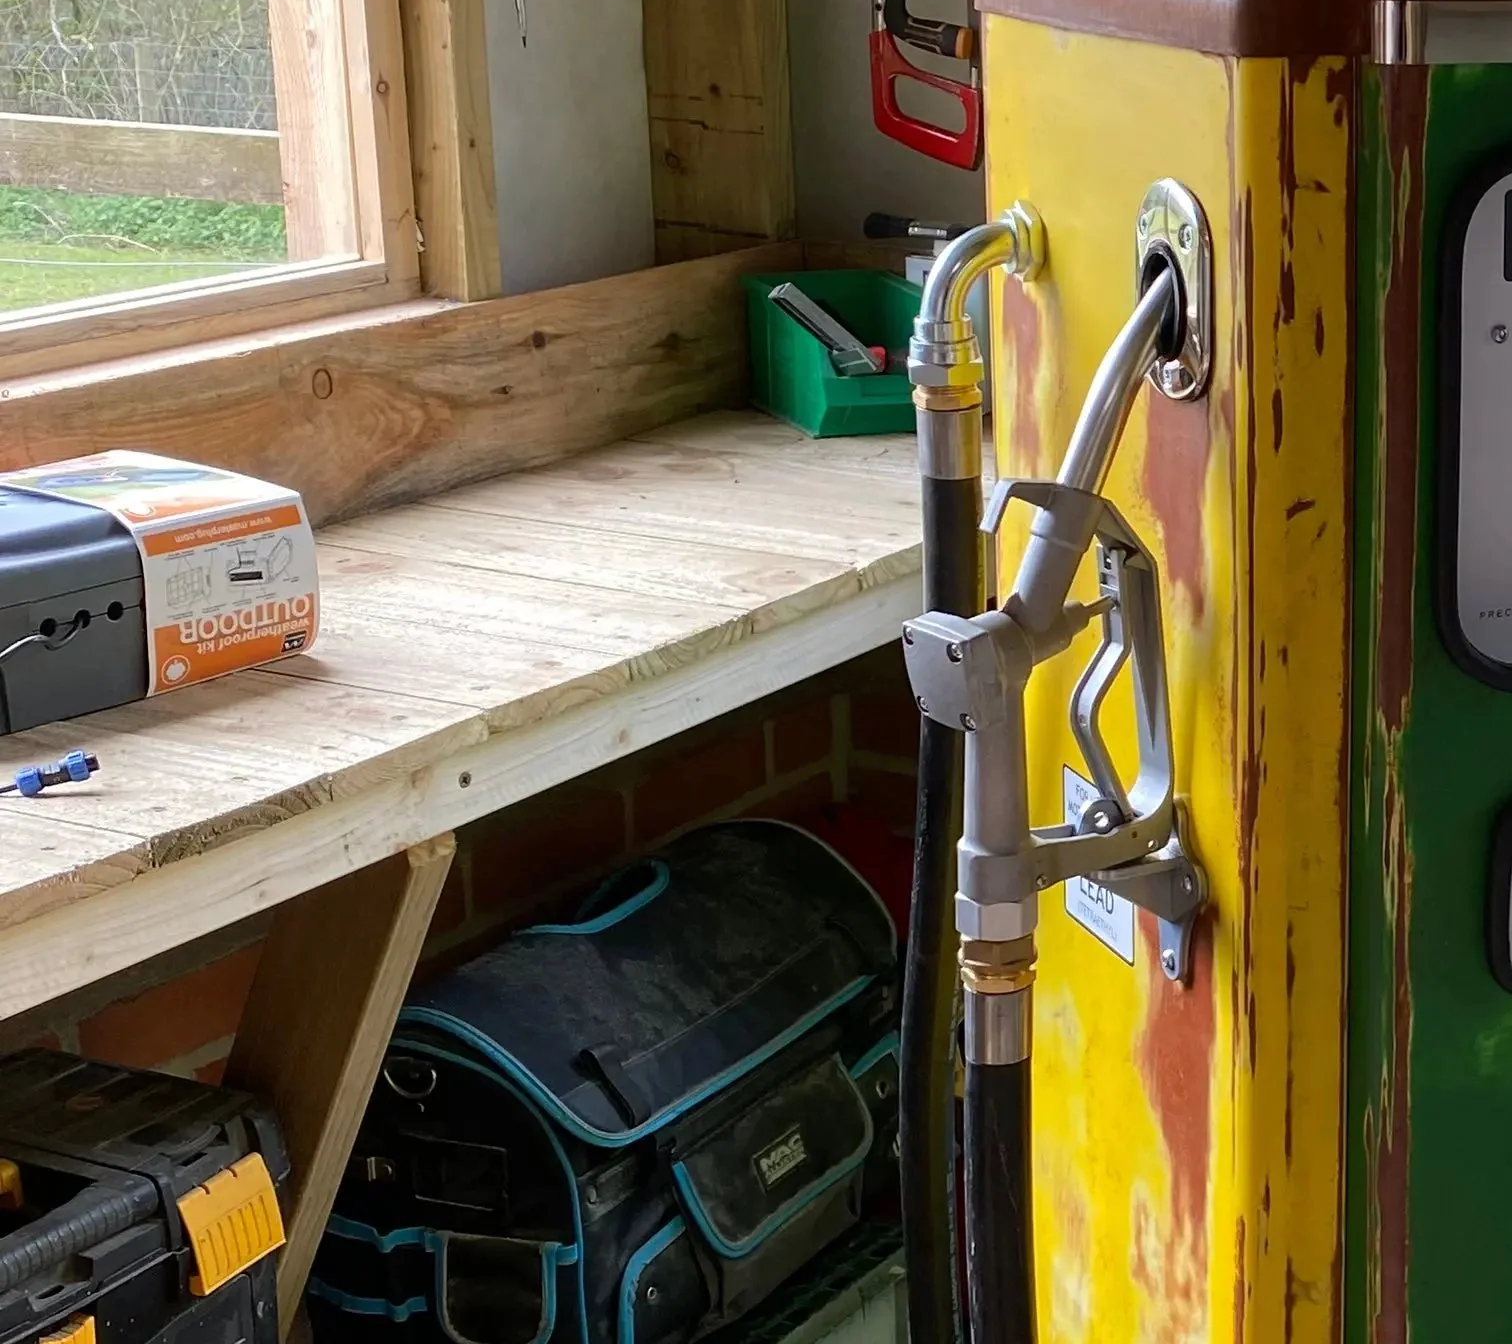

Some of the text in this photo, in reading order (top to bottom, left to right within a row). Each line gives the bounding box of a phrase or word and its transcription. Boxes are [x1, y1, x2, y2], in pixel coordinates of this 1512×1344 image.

[179, 595, 310, 644] OUTDOOR
[196, 617, 310, 655] weatherproof kit
[1080, 876, 1115, 915] LEAD
